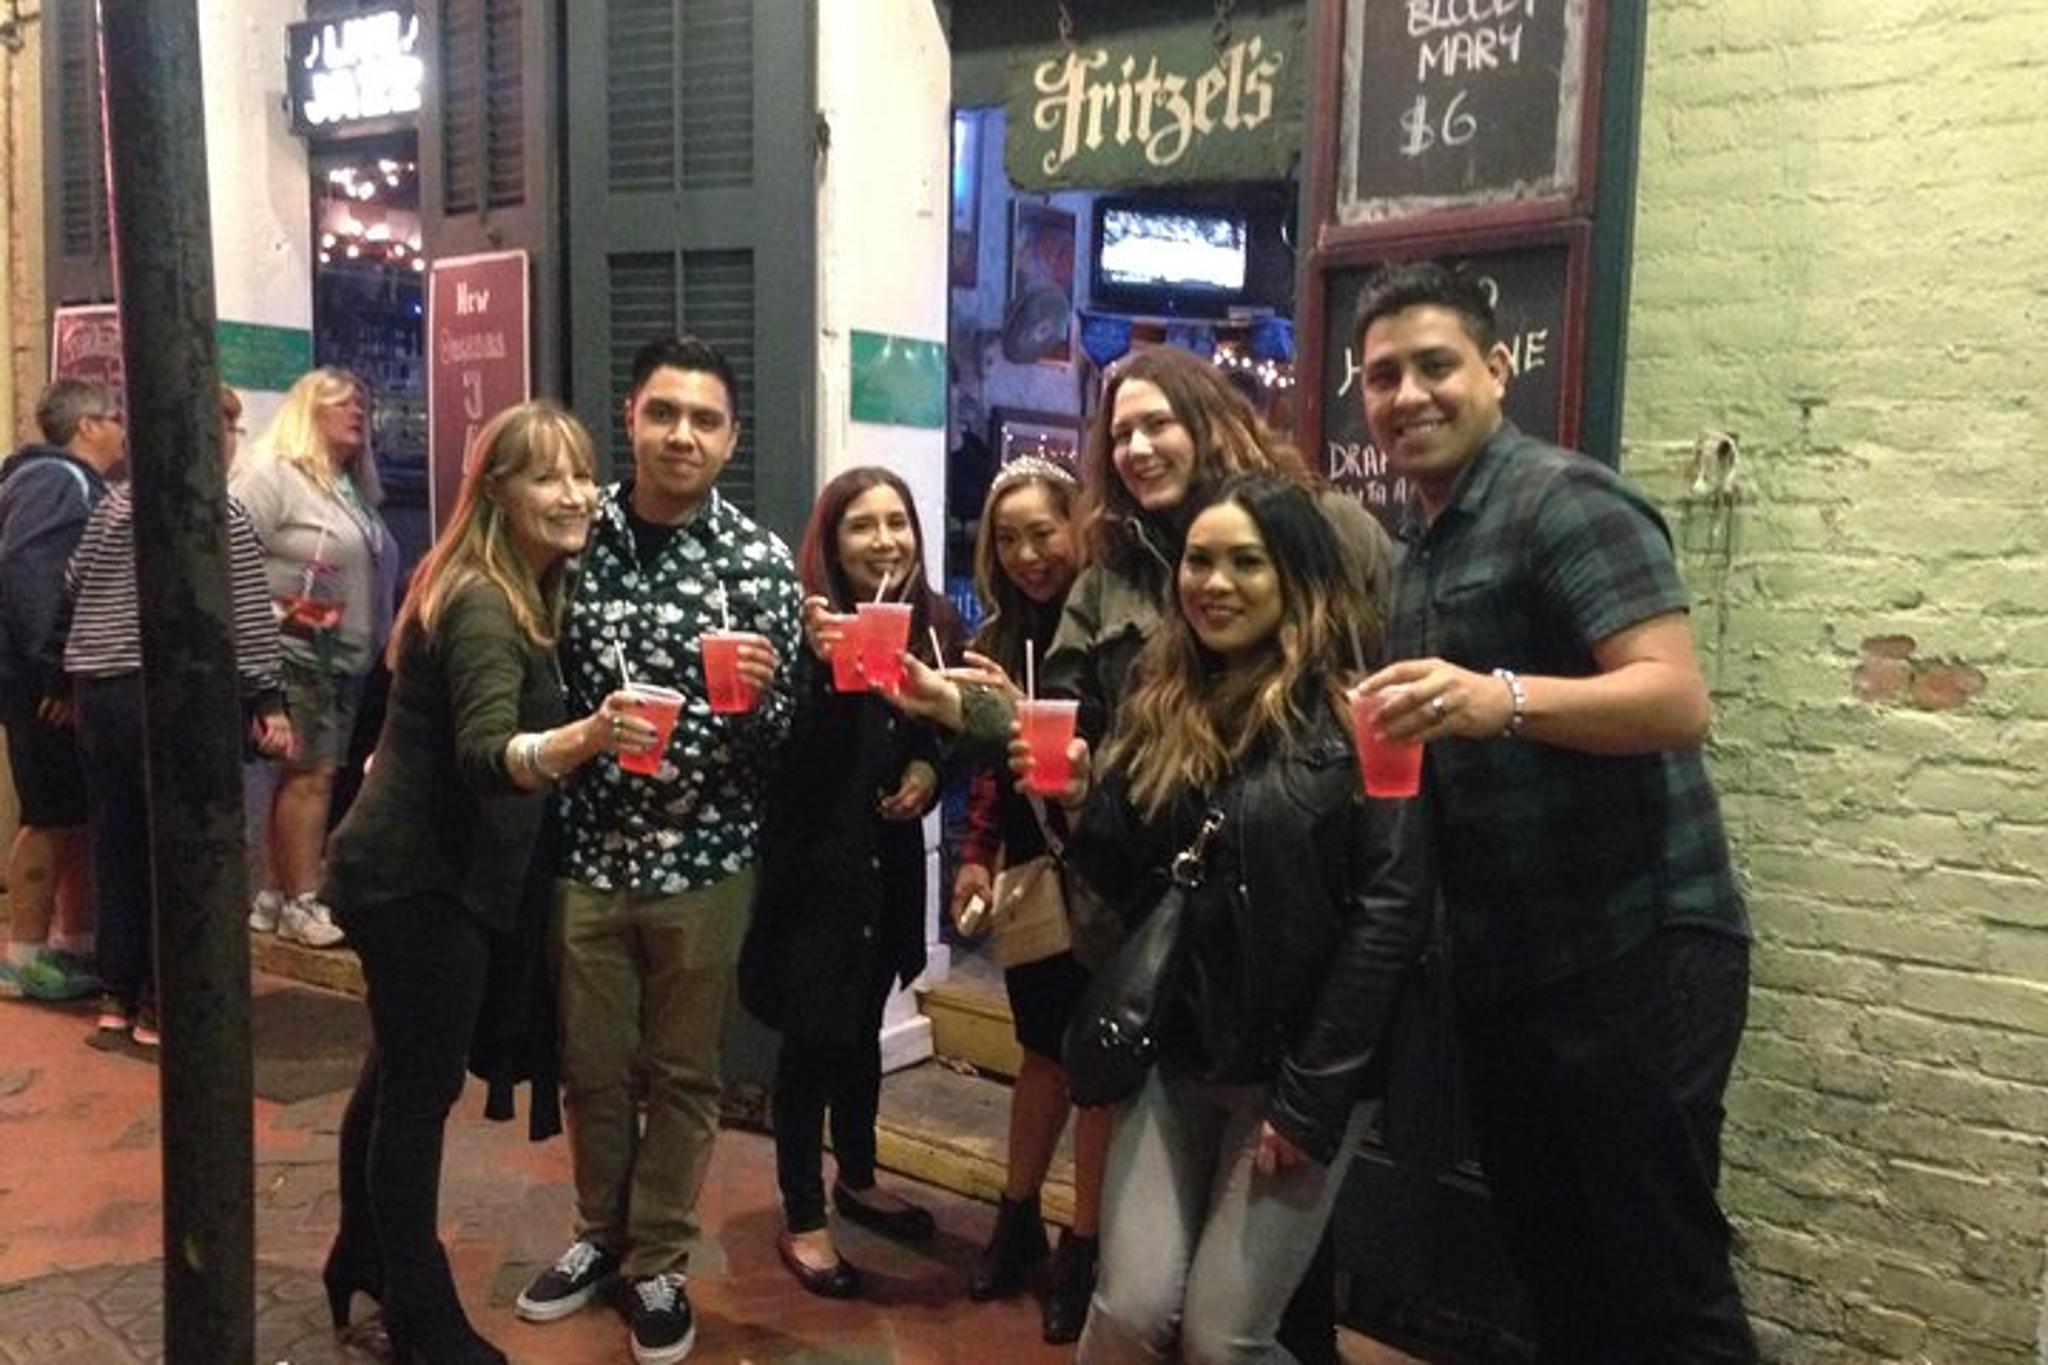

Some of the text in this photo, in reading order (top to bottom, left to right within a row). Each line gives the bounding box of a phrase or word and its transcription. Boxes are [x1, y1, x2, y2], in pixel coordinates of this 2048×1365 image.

[1418, 23, 1523, 82] MARY
[1034, 36, 1284, 174] Fritzel's
[1400, 90, 1477, 157] $6
